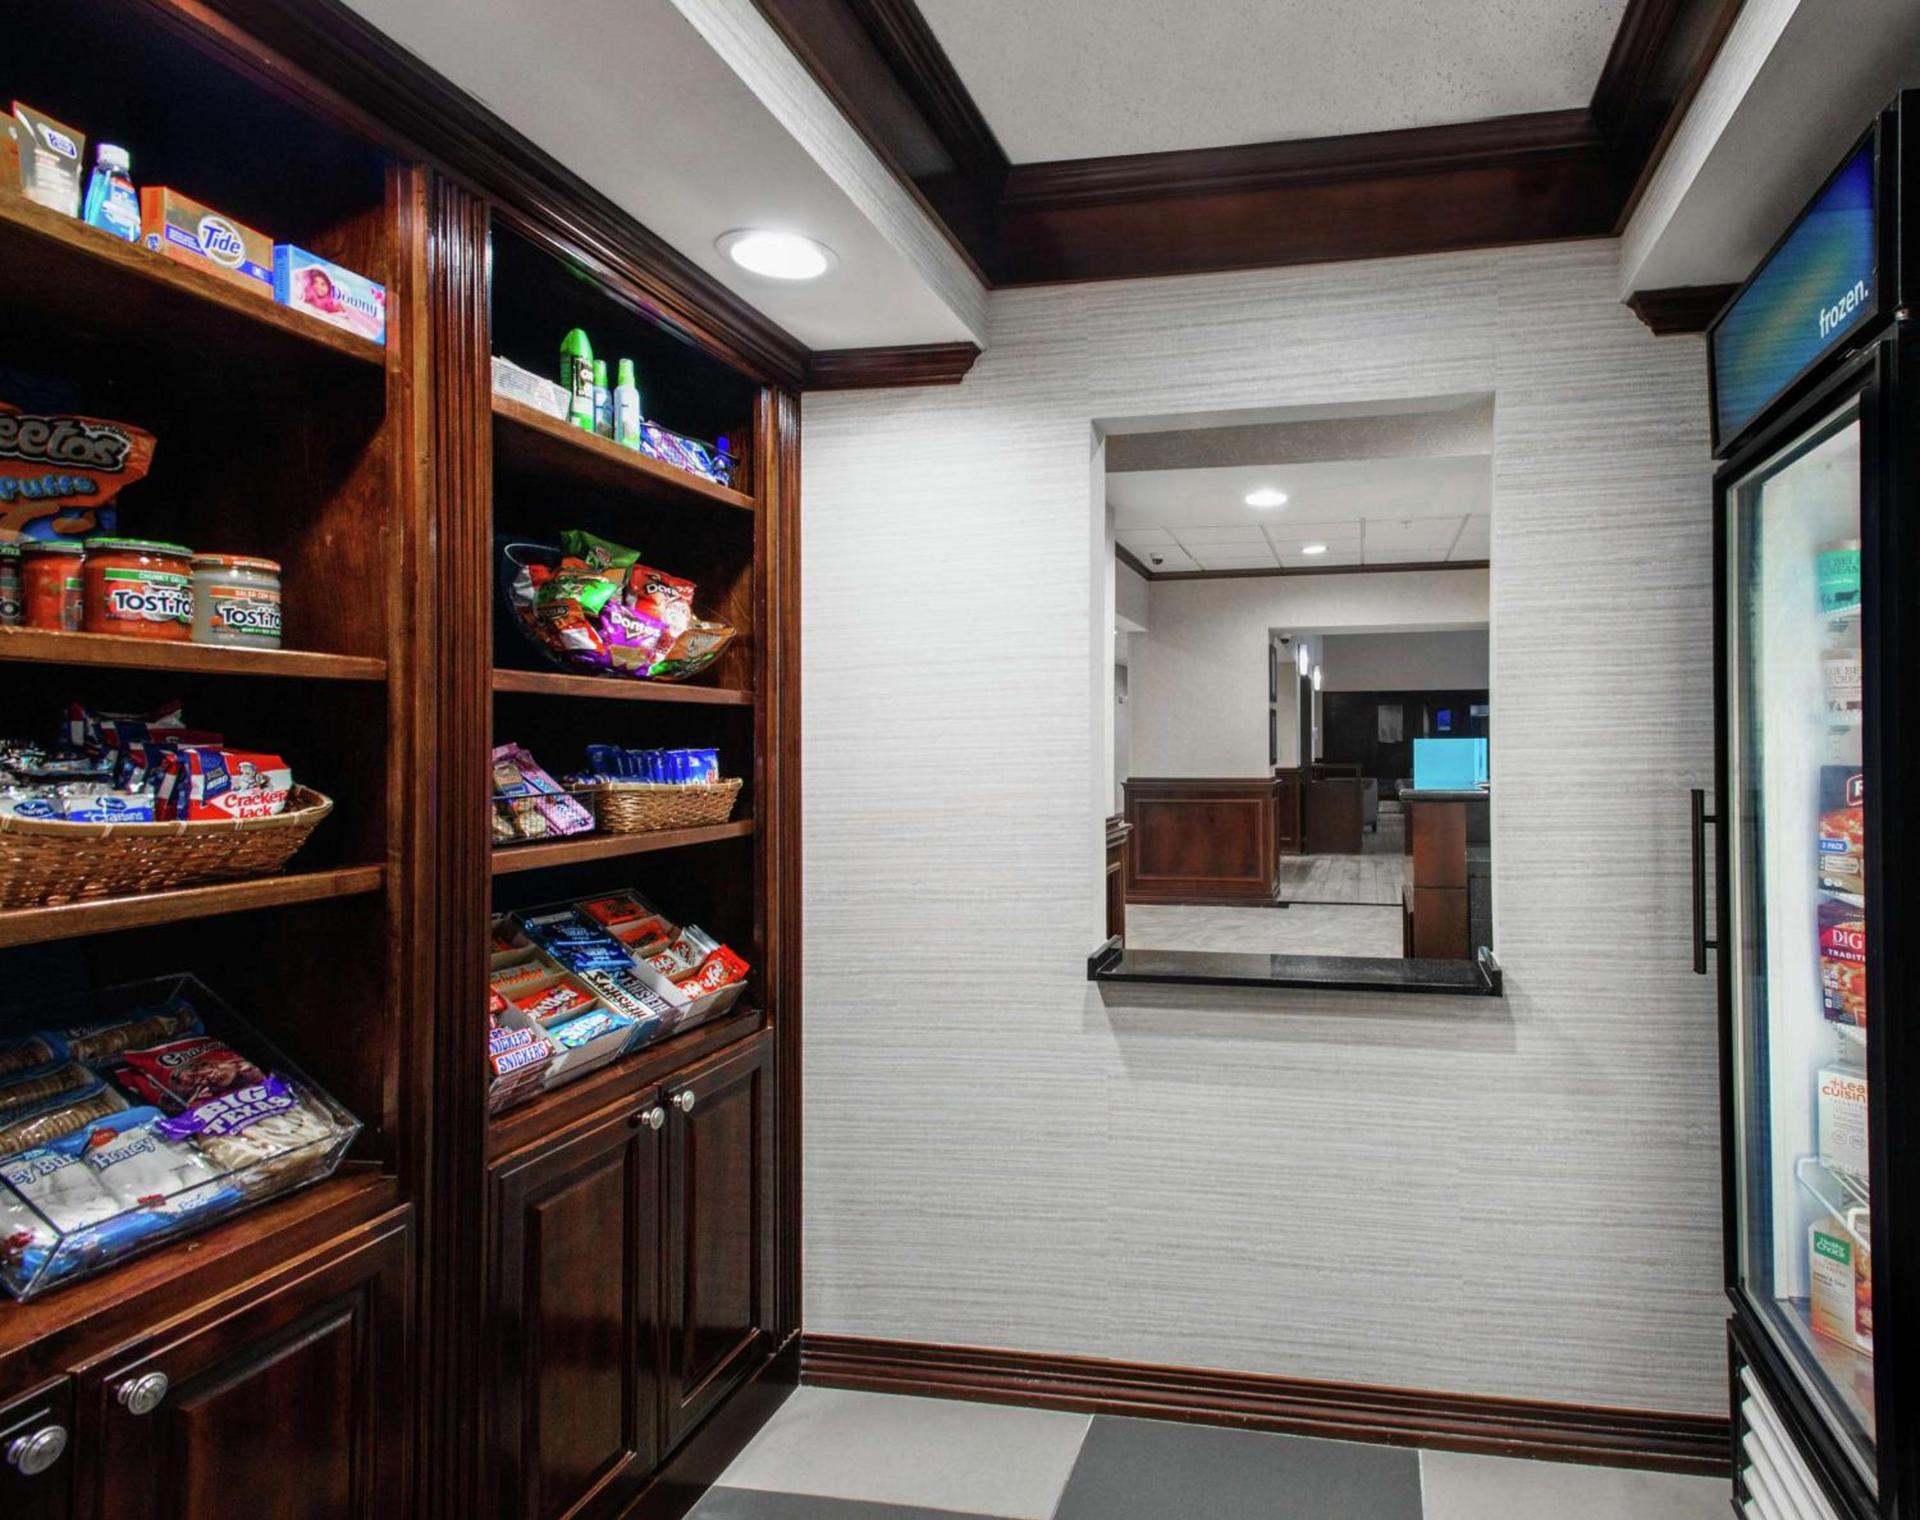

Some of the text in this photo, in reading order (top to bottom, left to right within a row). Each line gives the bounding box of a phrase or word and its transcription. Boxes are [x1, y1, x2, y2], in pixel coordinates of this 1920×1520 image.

[203, 225, 240, 254] Tide
[331, 284, 377, 318] Downy
[1818, 280, 1869, 339] frozen.
[224, 791, 288, 808] Cracker
[490, 1031, 529, 1053] NICKERS
[497, 1043, 546, 1073] SNICKERS
[194, 1086, 267, 1122] BIG
[202, 1096, 292, 1134] TEXAS
[91, 1137, 156, 1170] Honey
